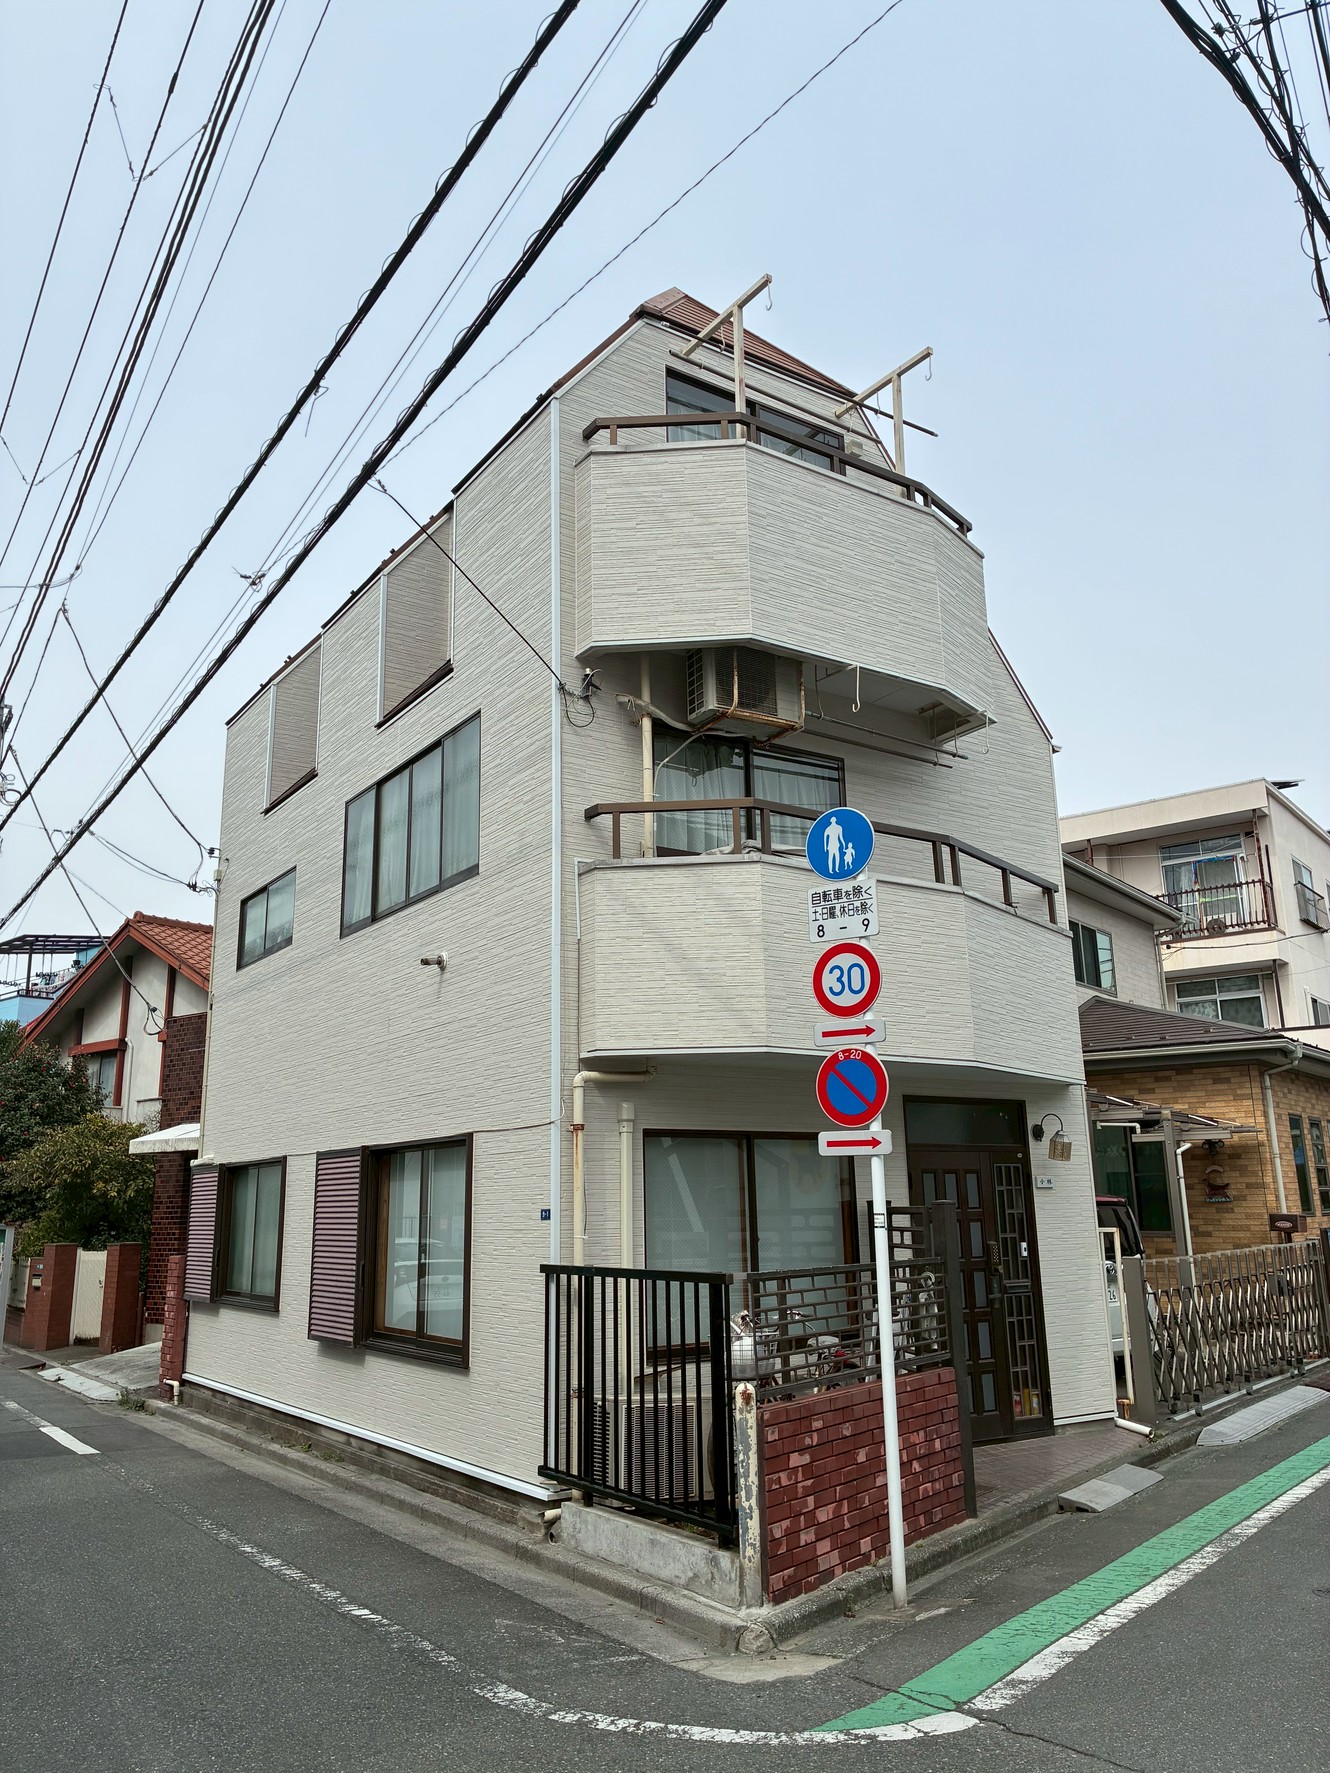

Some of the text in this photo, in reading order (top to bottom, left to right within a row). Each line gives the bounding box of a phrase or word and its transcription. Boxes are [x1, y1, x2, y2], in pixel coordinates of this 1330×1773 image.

[811, 885, 873, 905] 自転車を除く
[817, 924, 825, 938] 8
[861, 918, 870, 932] 9
[828, 962, 865, 997] 30
[837, 1049, 862, 1061] 8-20
